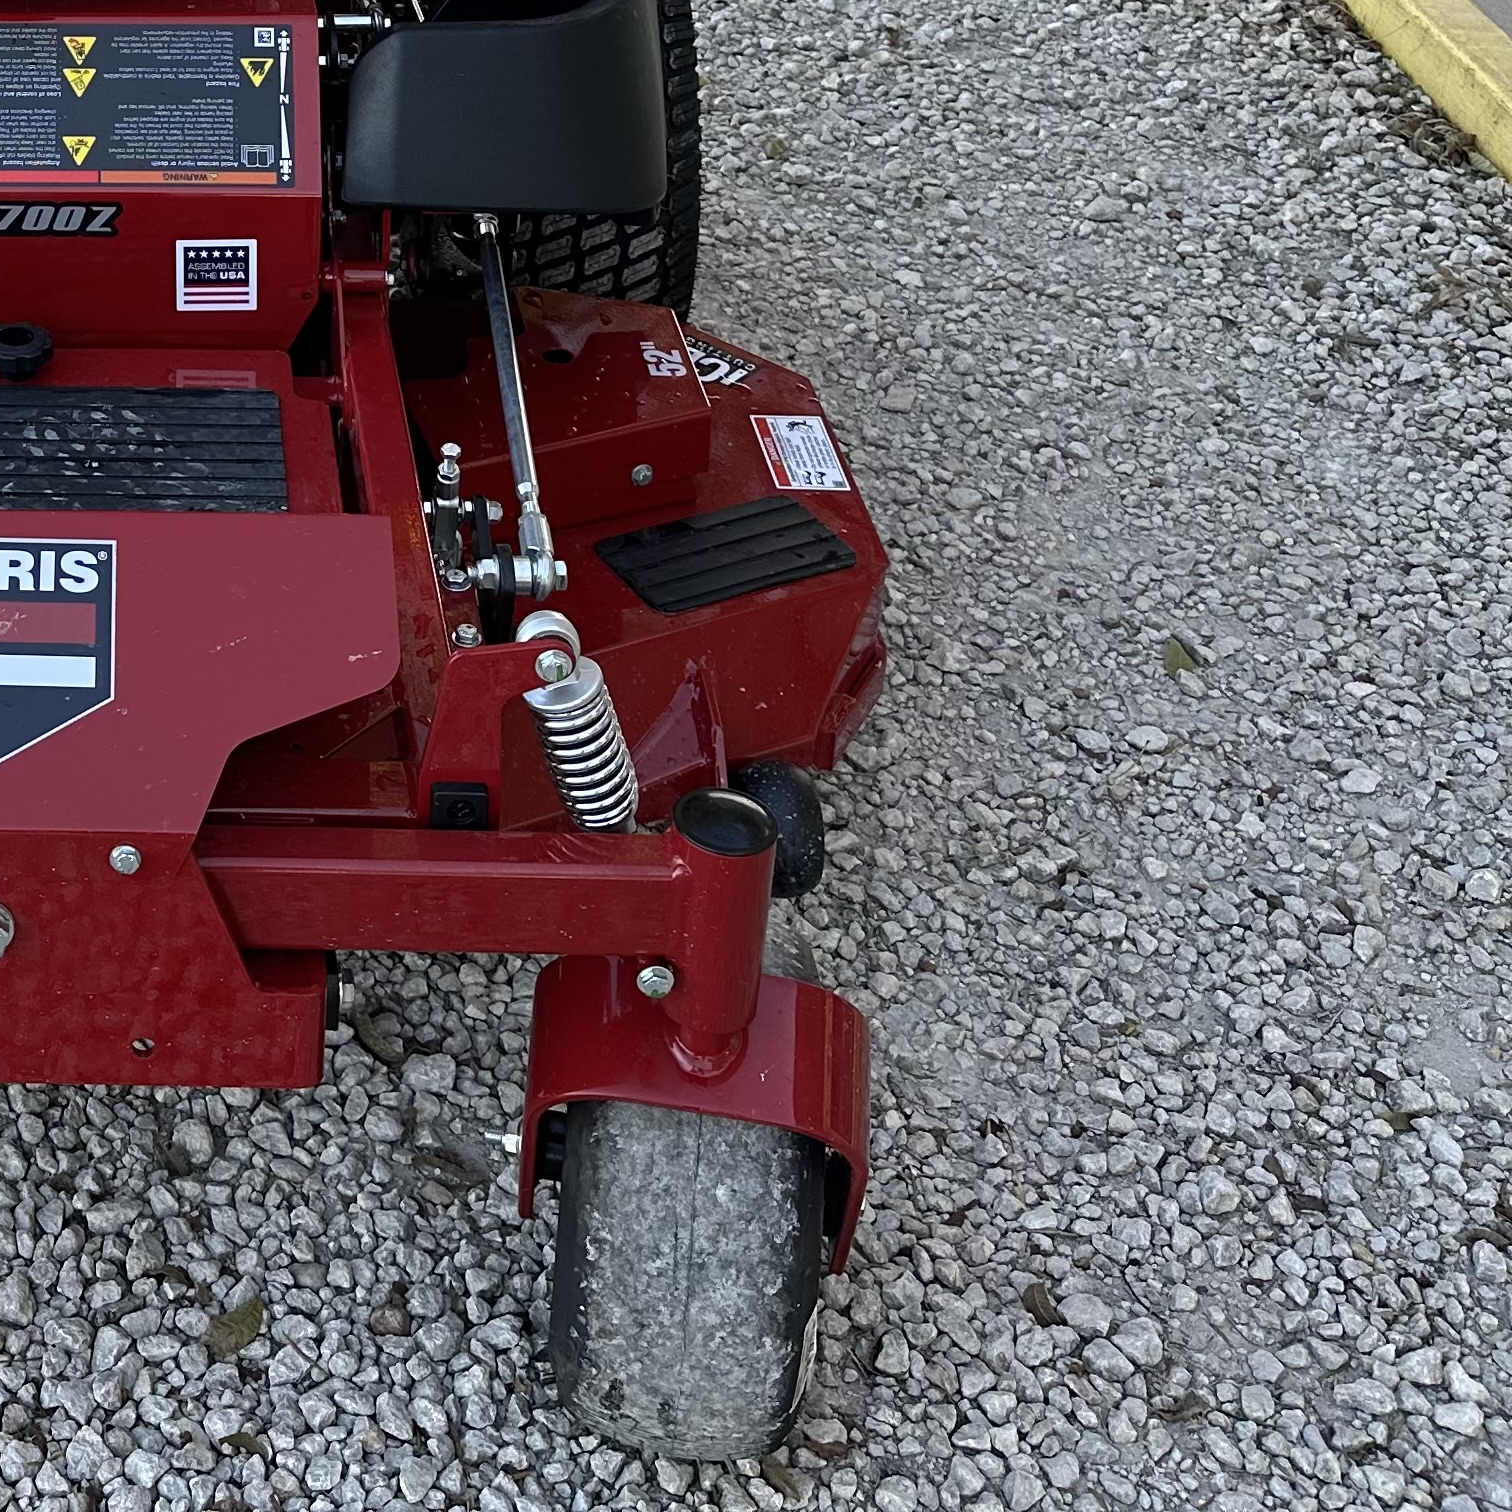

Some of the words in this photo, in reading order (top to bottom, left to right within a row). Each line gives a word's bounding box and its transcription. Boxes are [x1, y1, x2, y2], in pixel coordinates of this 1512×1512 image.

[162, 173, 208, 181] WARNING
[188, 262, 245, 270] ASSEMBLED
[188, 272, 198, 280] IN
[200, 272, 217, 280] THE
[220, 272, 246, 280] USA
